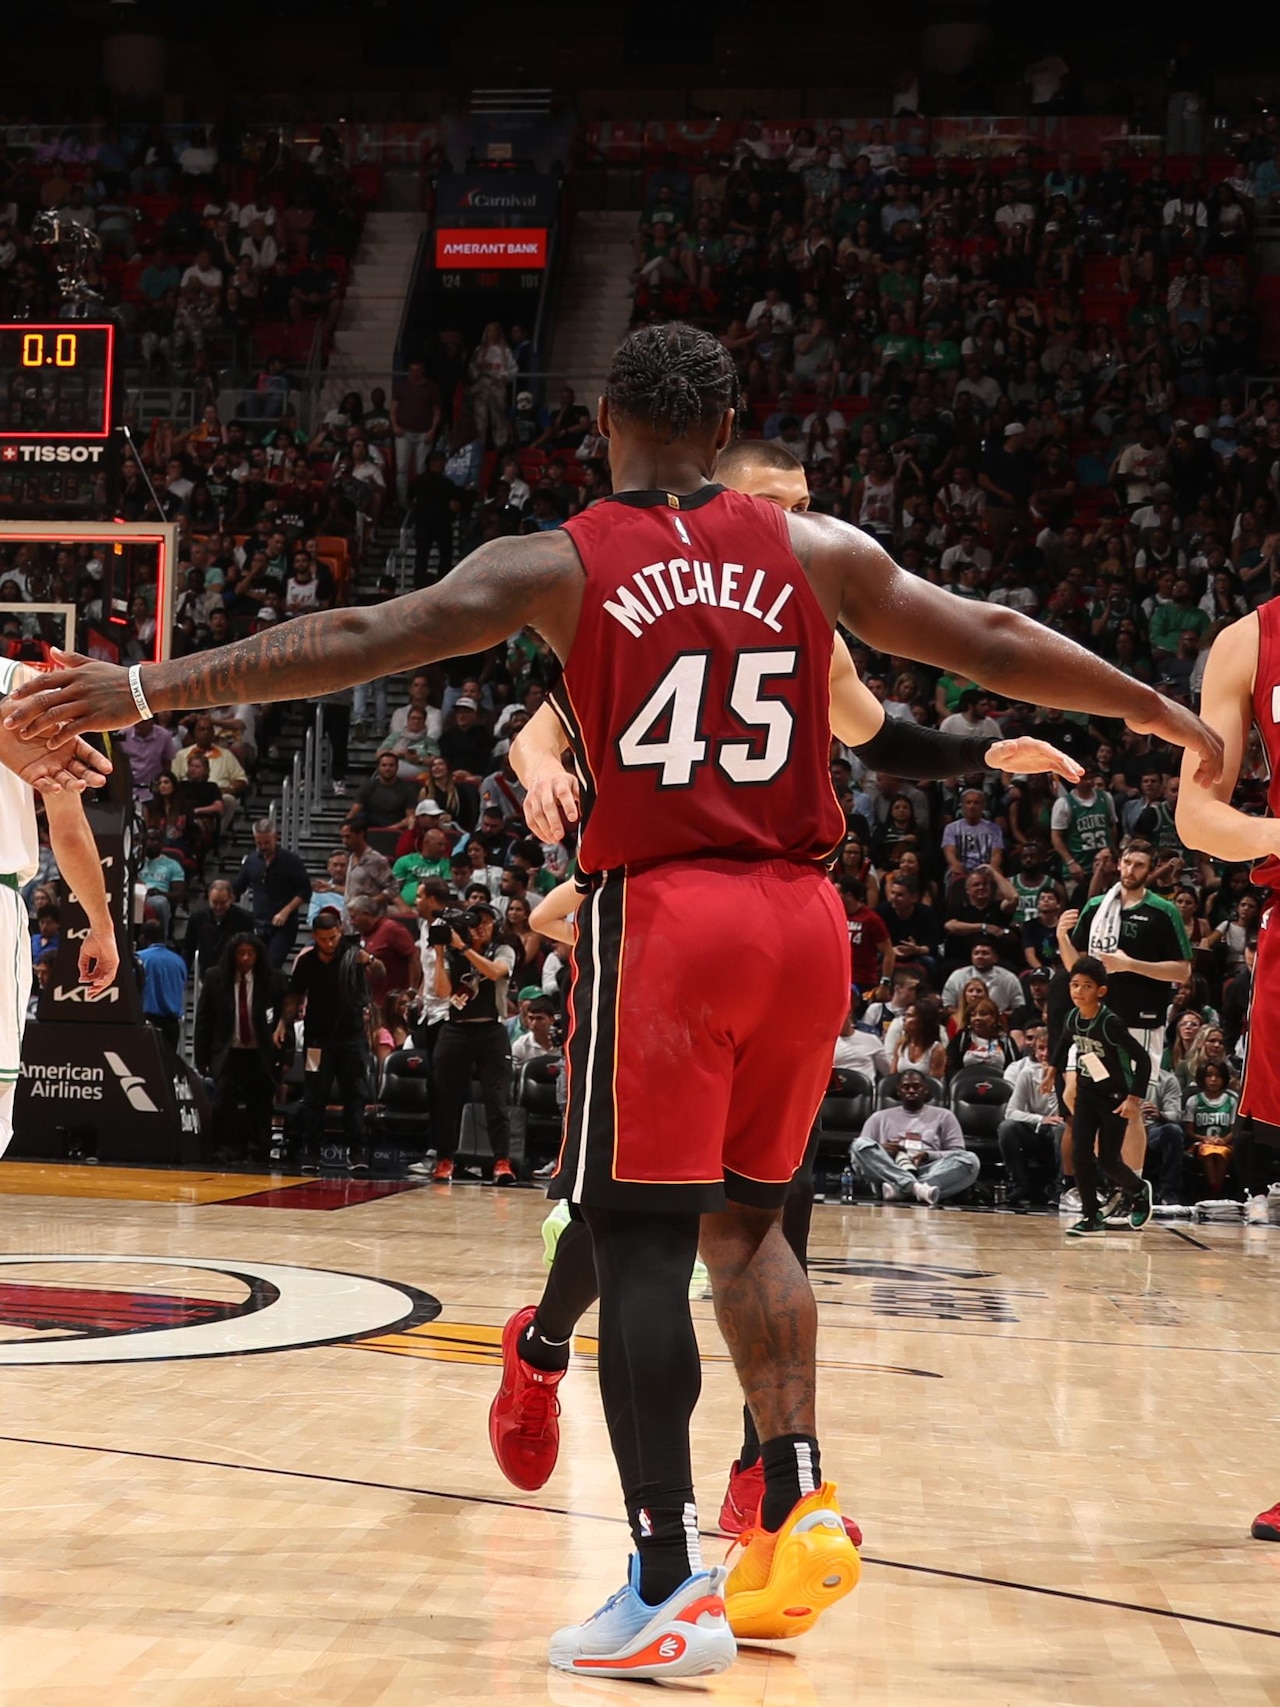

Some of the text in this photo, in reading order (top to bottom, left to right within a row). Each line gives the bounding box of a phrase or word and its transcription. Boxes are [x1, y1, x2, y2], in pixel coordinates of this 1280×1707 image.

[475, 194, 537, 207] Carnival
[443, 243, 539, 254] AMERANT BANK
[23, 334, 77, 366] 0.0
[19, 445, 104, 462] TISSOT
[602, 557, 794, 638] MITCHELL
[616, 648, 798, 787] 45
[19, 1060, 104, 1082] American
[30, 1080, 104, 1100] Airlines
